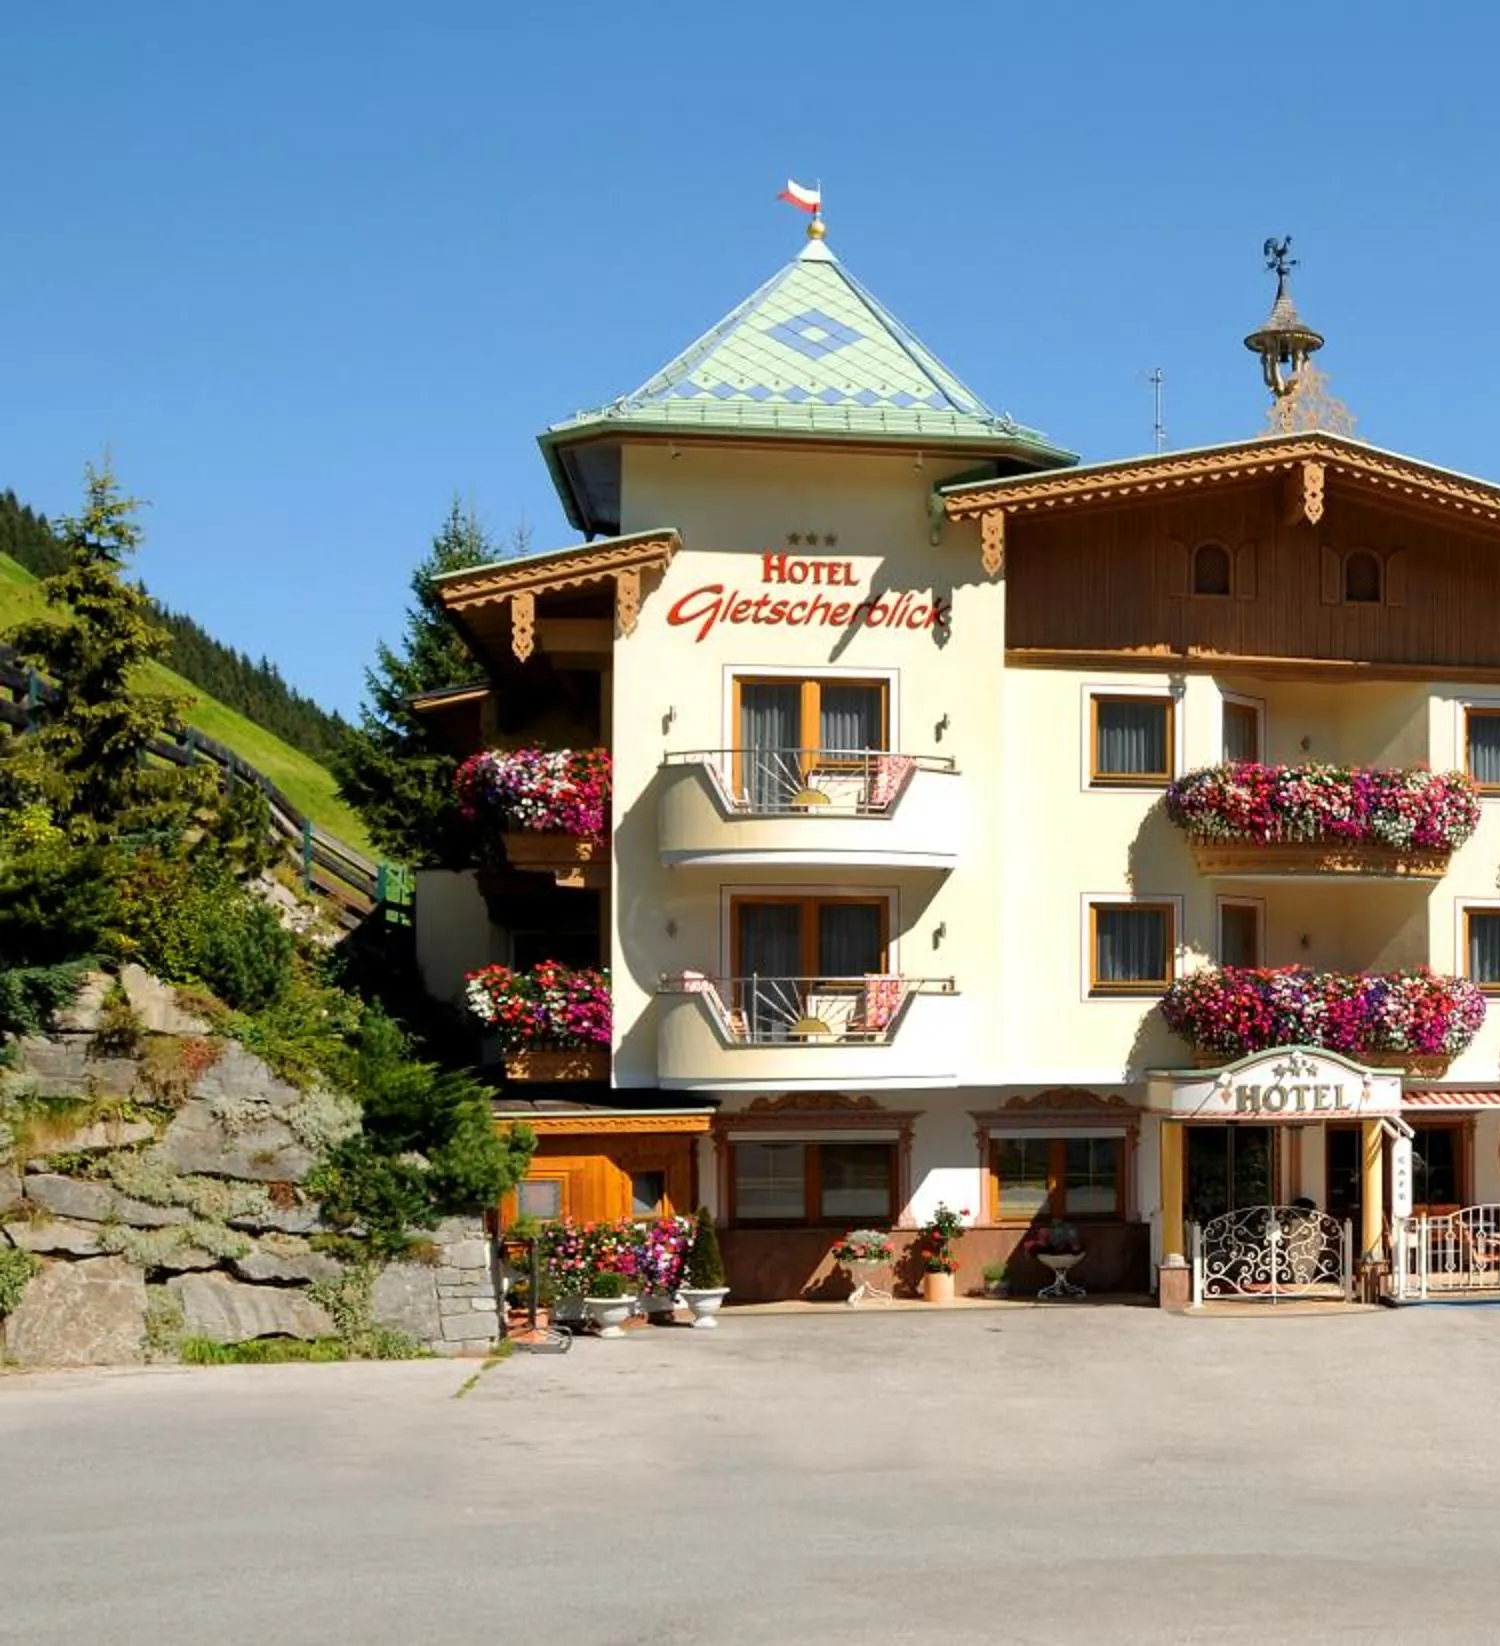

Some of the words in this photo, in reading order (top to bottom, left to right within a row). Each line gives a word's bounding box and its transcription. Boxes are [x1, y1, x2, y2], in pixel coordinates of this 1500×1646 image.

[761, 548, 860, 586] HOTEL
[666, 584, 951, 643] Gletscherblick
[1235, 1083, 1352, 1113] HOTEL
